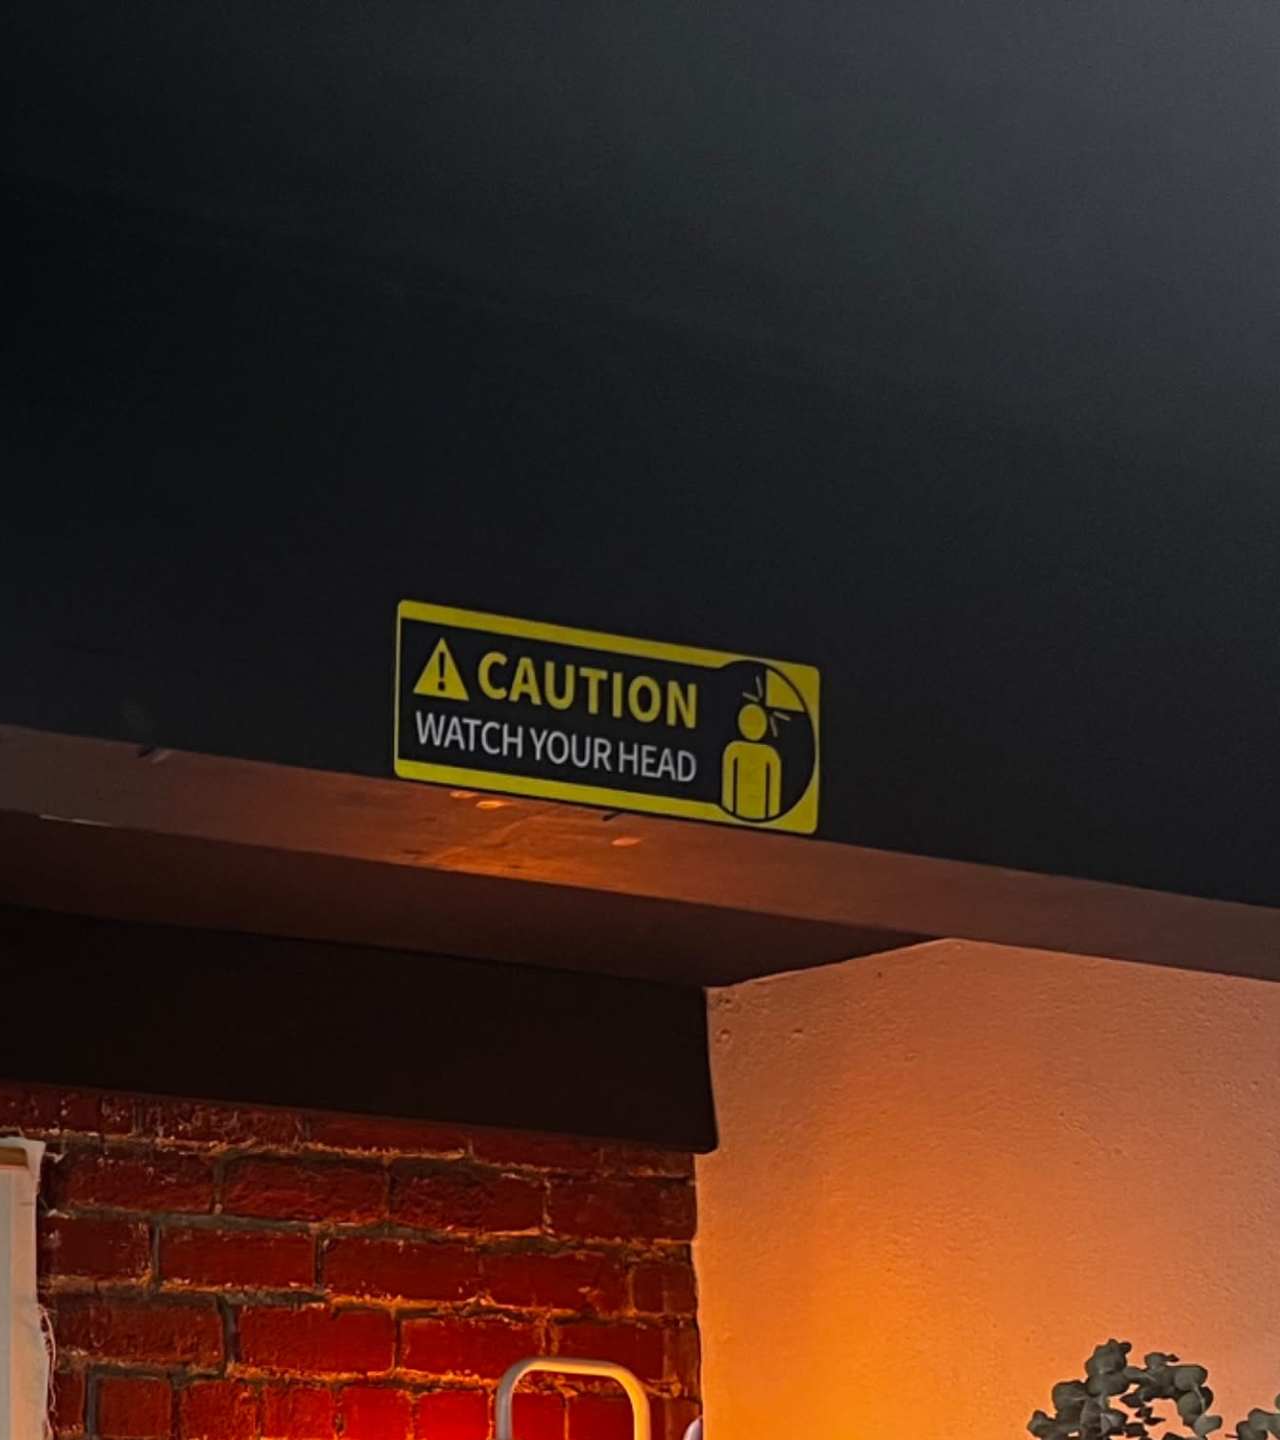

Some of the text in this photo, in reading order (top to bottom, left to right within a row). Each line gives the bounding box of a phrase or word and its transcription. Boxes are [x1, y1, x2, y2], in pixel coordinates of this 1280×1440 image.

[477, 651, 697, 729] CAUTION
[415, 710, 697, 783] WATCH YOUR HEAD
